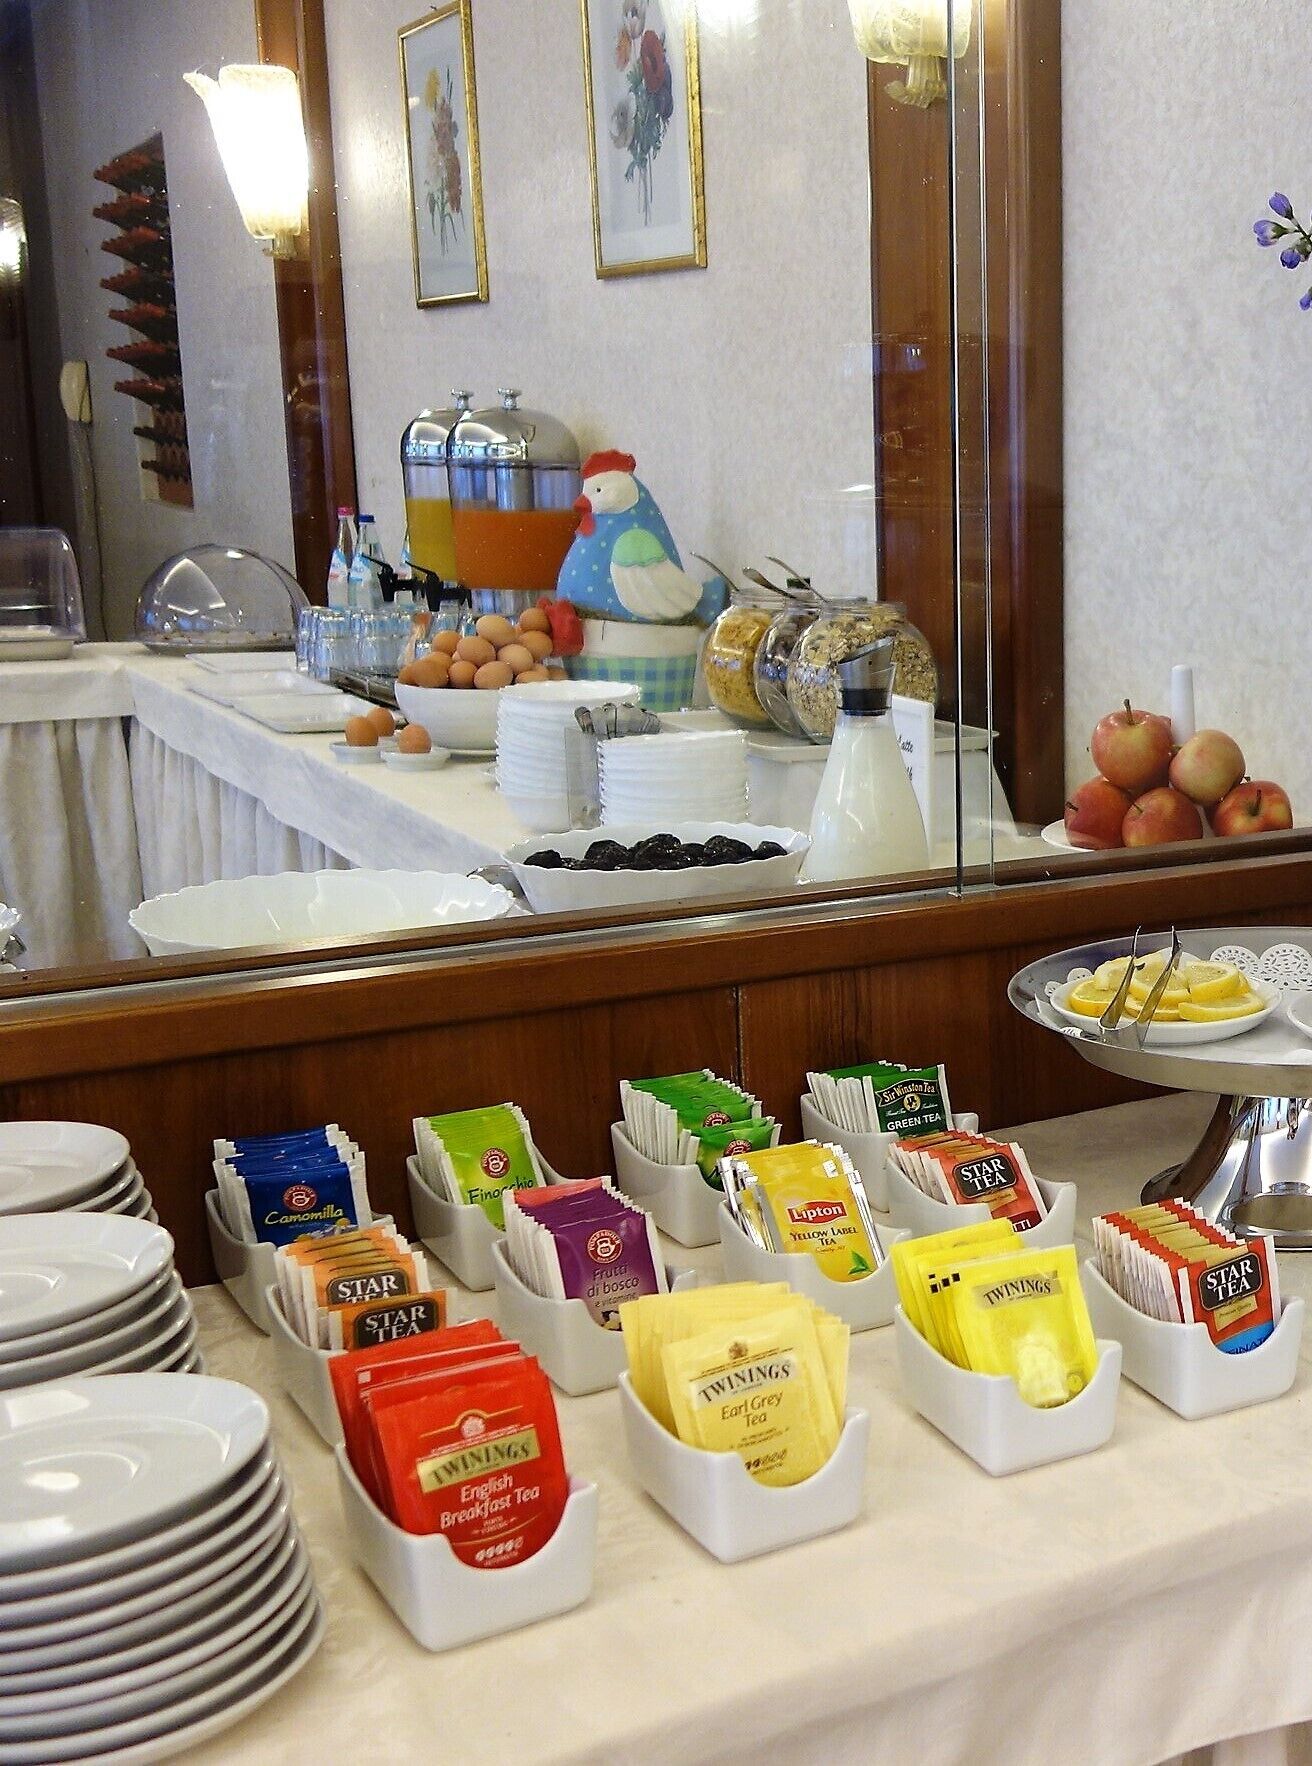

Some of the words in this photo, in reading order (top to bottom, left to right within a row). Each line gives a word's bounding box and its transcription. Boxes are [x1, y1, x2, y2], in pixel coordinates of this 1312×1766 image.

[882, 1091, 895, 1103] Sir
[893, 1083, 922, 1097] Winston
[924, 1082, 936, 1093] Tea
[887, 1117, 921, 1131] GREEN
[922, 1113, 941, 1123] TEA
[961, 1158, 1005, 1181] STAR
[970, 1172, 1007, 1191] TEA
[264, 1204, 344, 1225] Camomilla
[792, 1206, 843, 1221] Lipton
[790, 1230, 828, 1241] YELLOW
[831, 1226, 858, 1236] LABEL
[818, 1238, 837, 1246] TEA
[593, 1264, 629, 1280] Frutti
[1207, 1259, 1253, 1290] STAR
[338, 1274, 399, 1299] STAR
[587, 1283, 600, 1298] di
[603, 1277, 640, 1295] bosco
[984, 1279, 1051, 1305] TWININGS
[1213, 1276, 1251, 1301] TEA
[365, 1305, 427, 1331] STAR
[373, 1321, 421, 1342] TEA
[698, 1362, 791, 1403] TWININGS
[721, 1400, 749, 1421] Earl
[751, 1391, 784, 1411] Grey
[744, 1412, 768, 1428] Tea
[431, 1440, 530, 1485] TWININGS
[460, 1473, 514, 1503] English
[440, 1494, 512, 1530] Breakfast
[515, 1486, 541, 1504] Tea
